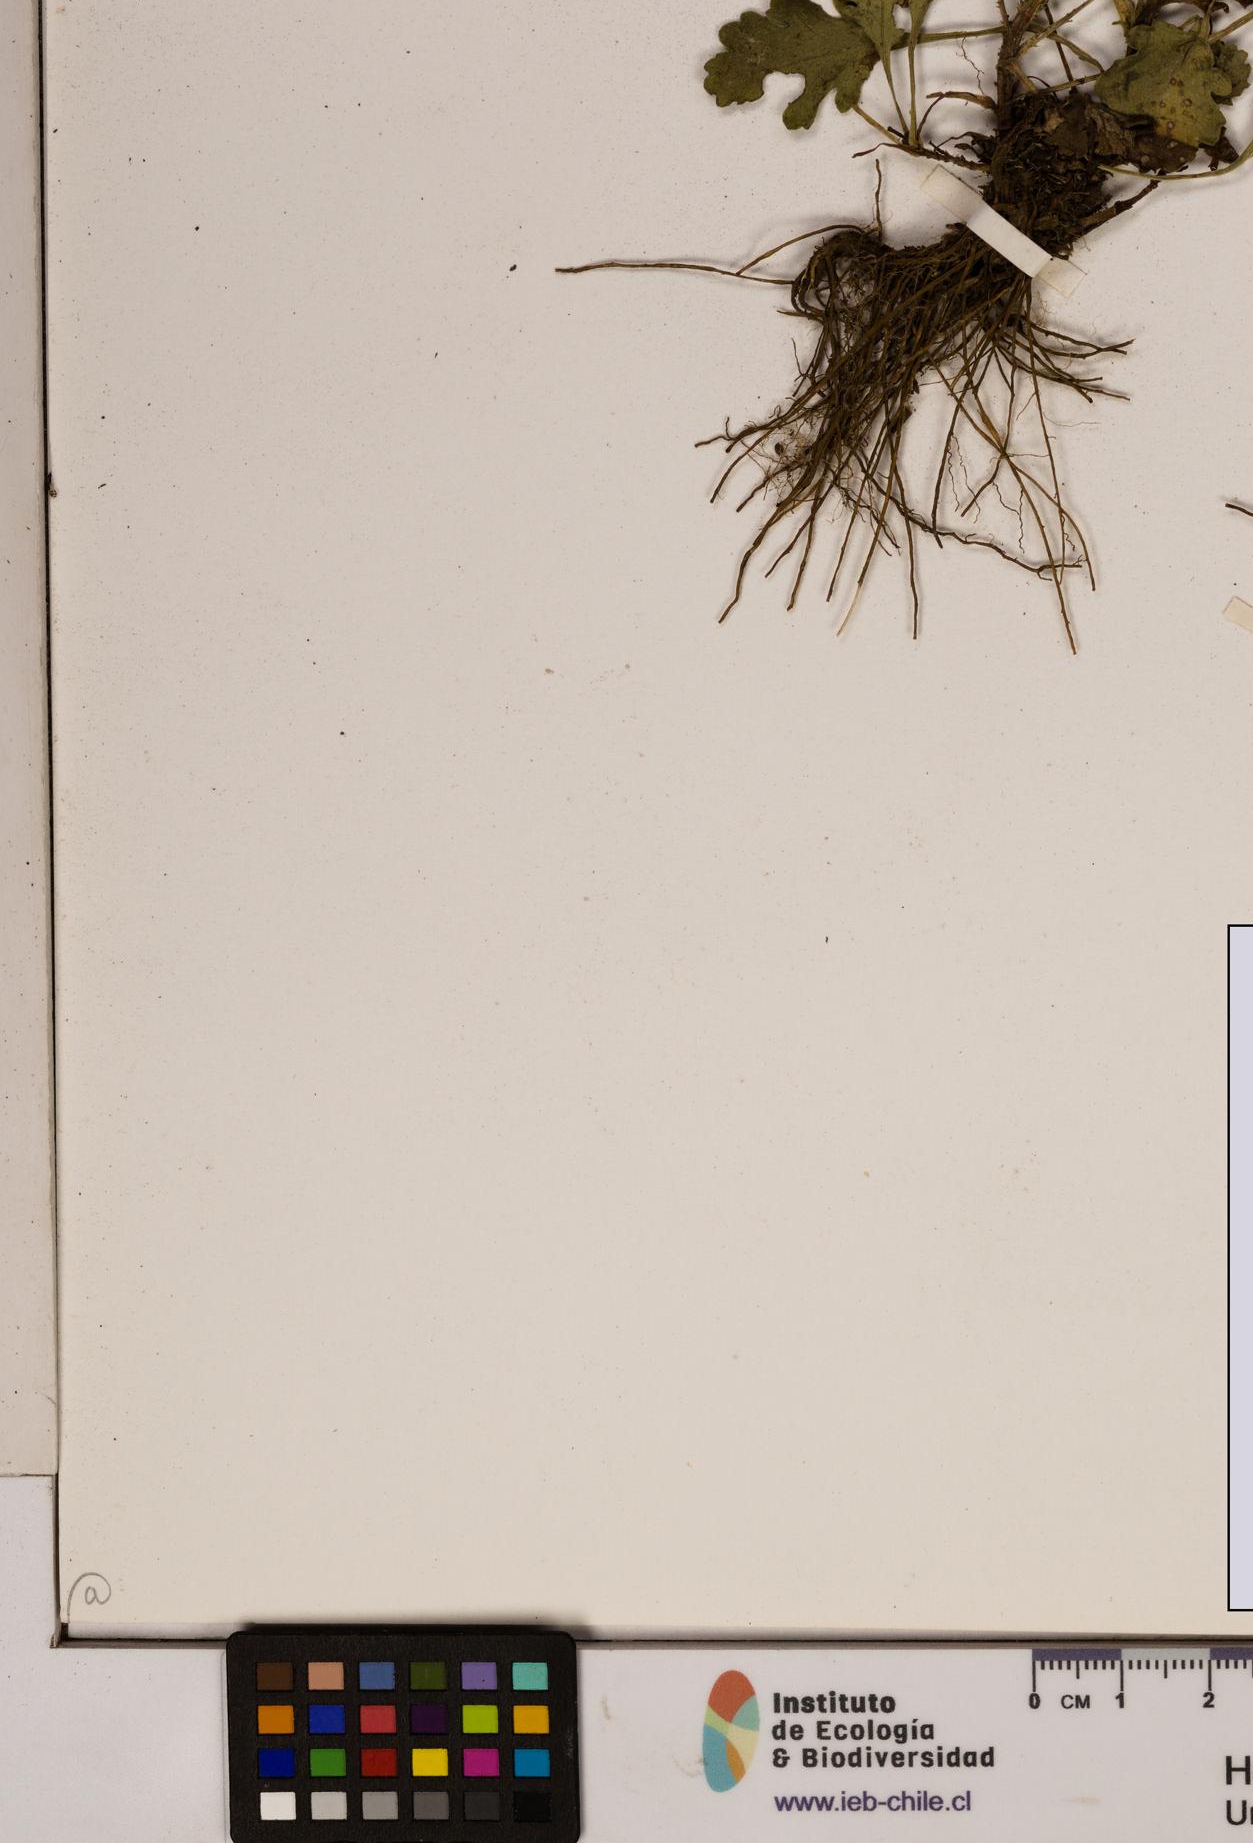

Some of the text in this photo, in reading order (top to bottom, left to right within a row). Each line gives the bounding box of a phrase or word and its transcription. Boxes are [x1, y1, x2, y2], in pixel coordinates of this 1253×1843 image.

[773, 1690, 897, 1714] Instituto
[1028, 1693, 1041, 1710] 0
[1060, 1694, 1091, 1710] CM
[1115, 1692, 1125, 1709] 1
[1202, 1692, 1215, 1709] 2
[771, 1718, 935, 1745] de Ecología
[772, 1746, 995, 1769] & Biodiversidad
[773, 1790, 971, 1812] www.ieb-chile.cl
